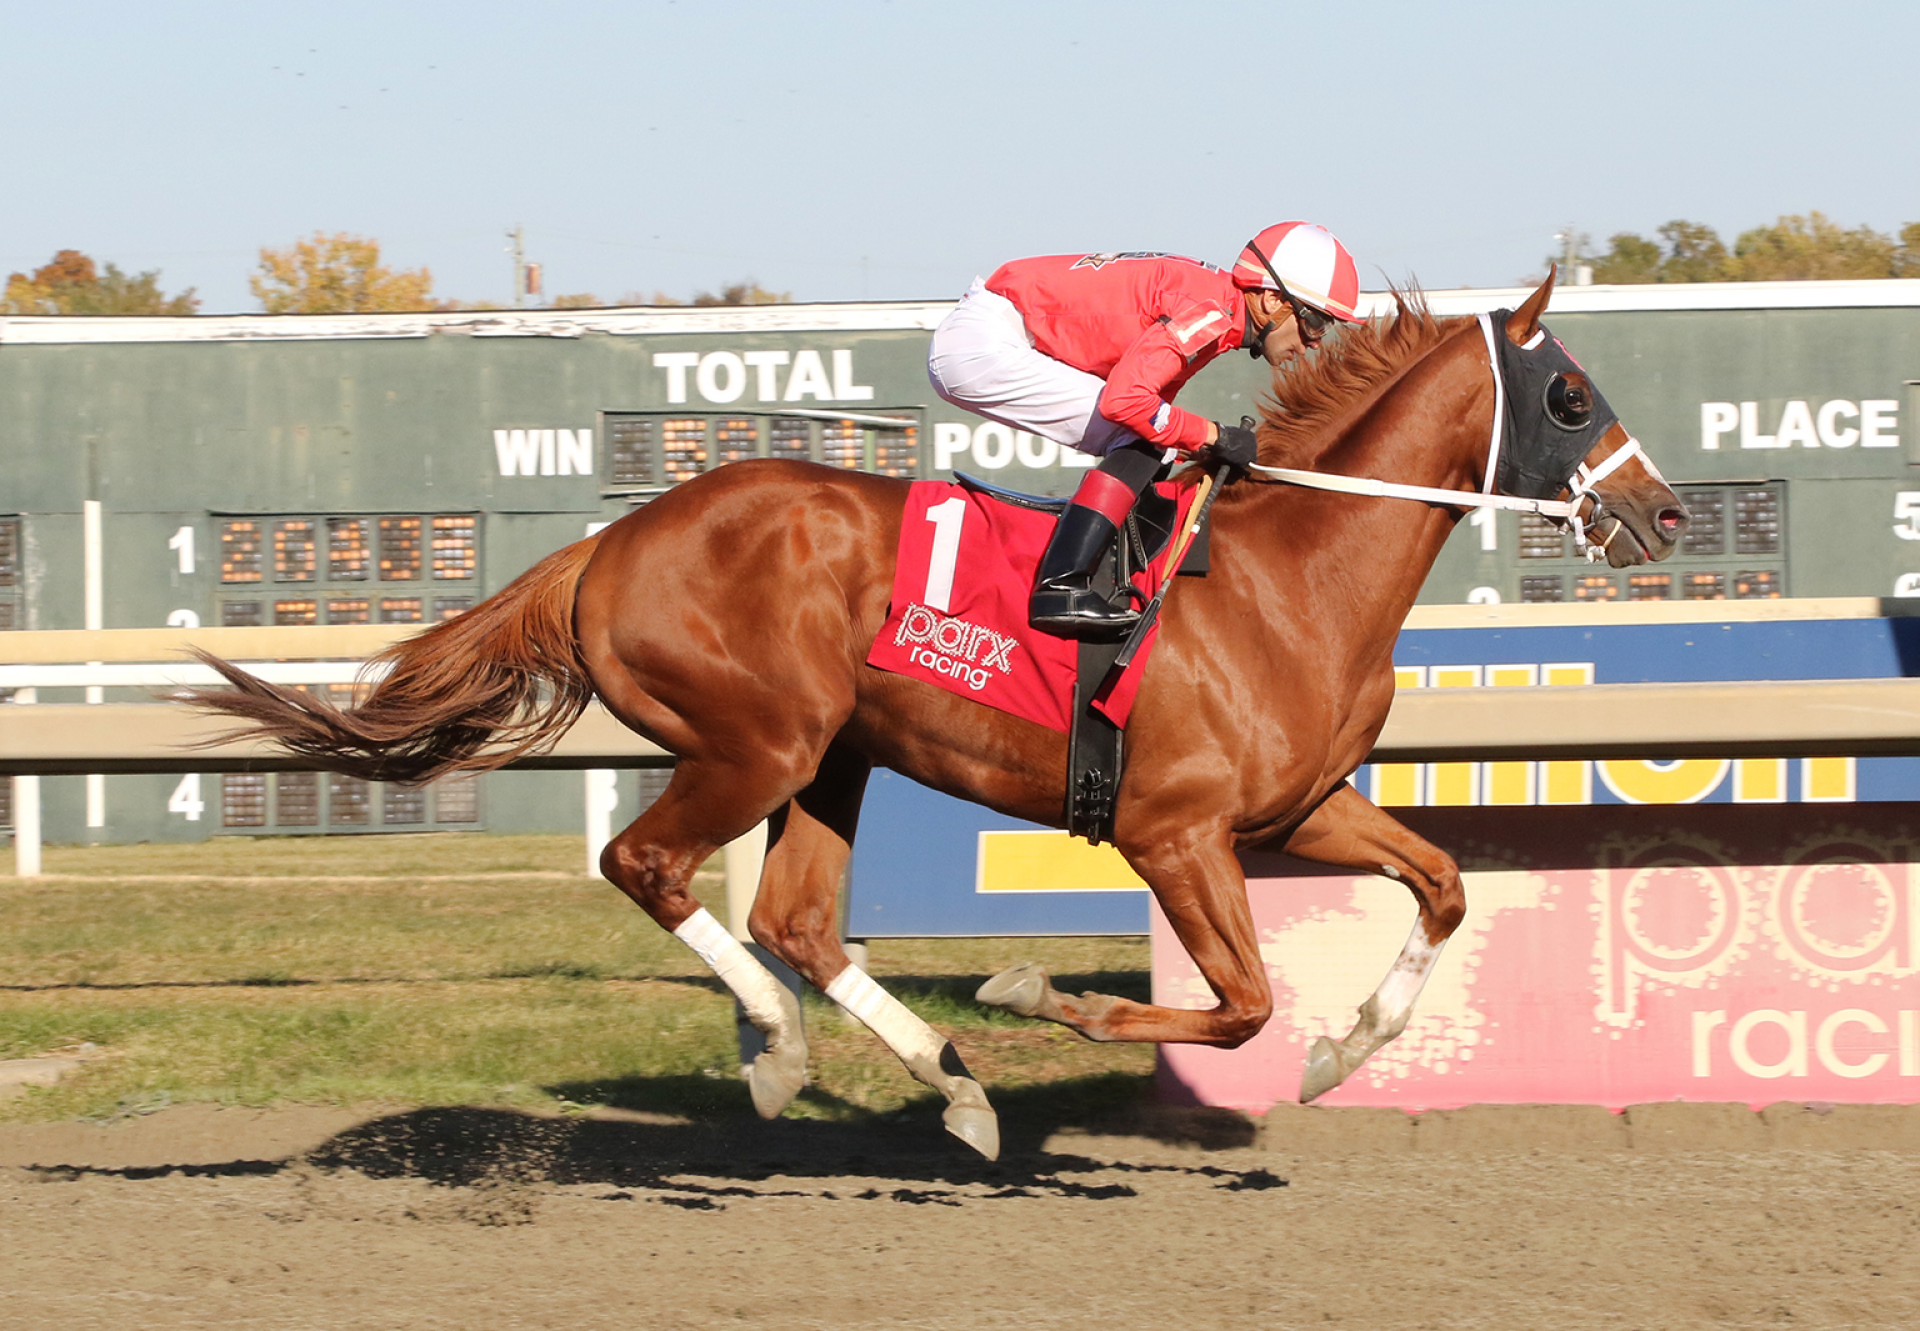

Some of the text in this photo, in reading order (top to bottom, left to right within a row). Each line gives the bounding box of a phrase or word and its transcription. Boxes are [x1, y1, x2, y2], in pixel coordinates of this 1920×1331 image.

[1176, 310, 1222, 344] 1
[653, 350, 874, 403] TOTAL
[1701, 399, 1900, 449] PLACE
[494, 429, 593, 476] WIN
[168, 526, 195, 573] 1
[1470, 508, 1497, 550] 1
[924, 497, 966, 612] 1
[893, 602, 1019, 675] parx
[909, 646, 993, 691] racing
[168, 773, 204, 820] 4
